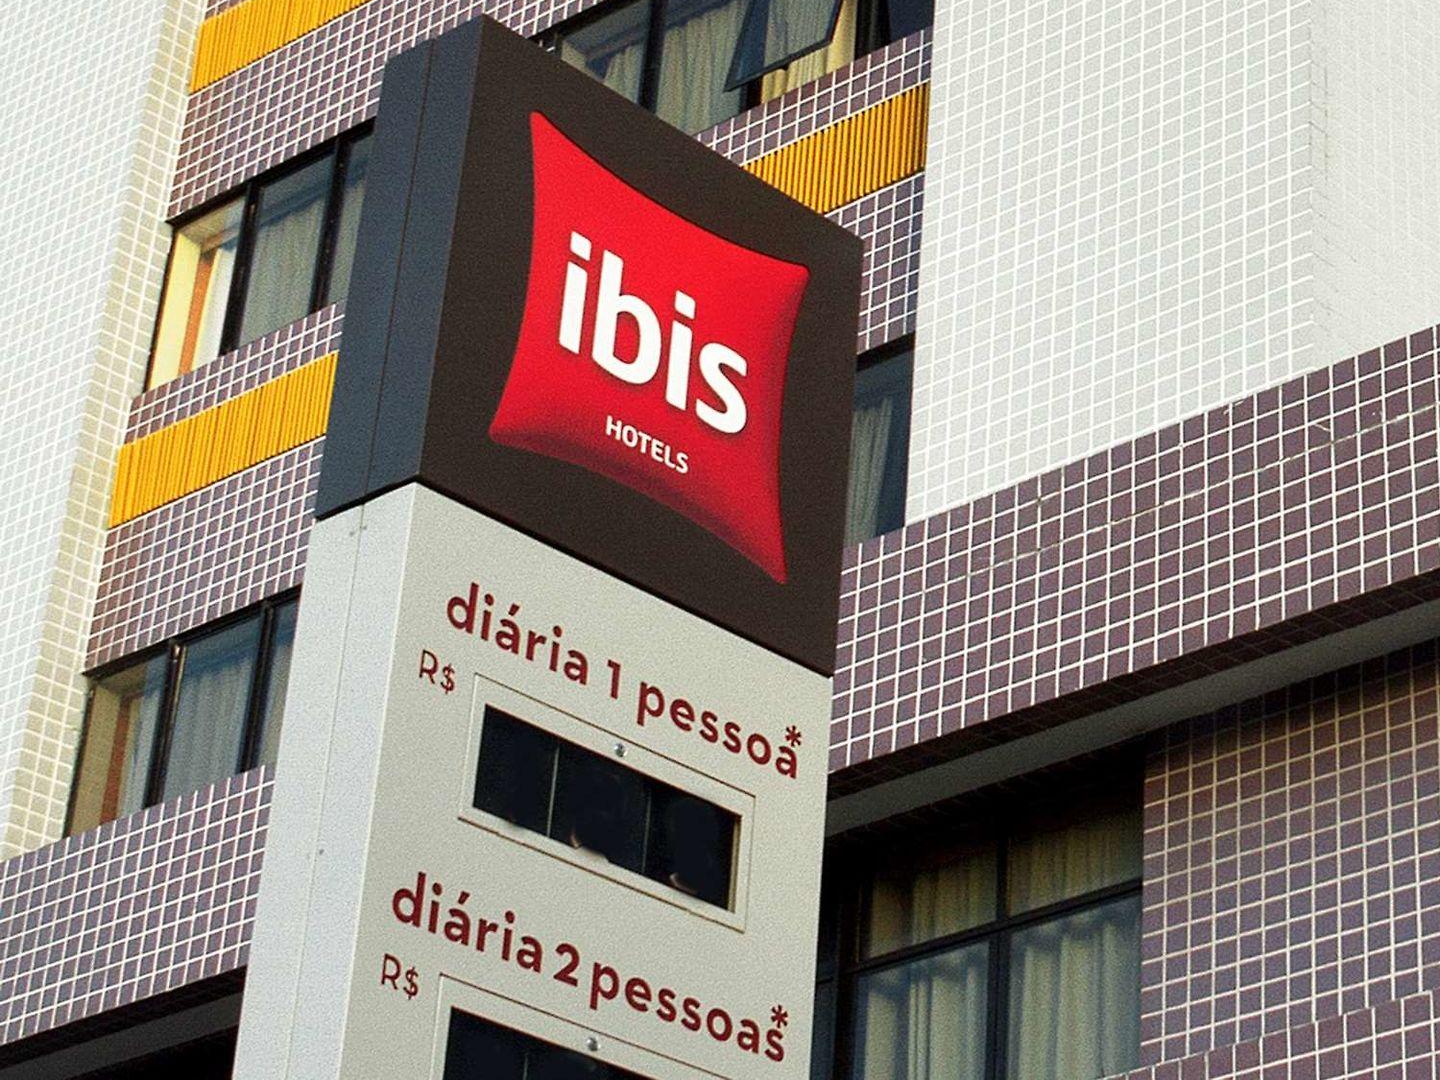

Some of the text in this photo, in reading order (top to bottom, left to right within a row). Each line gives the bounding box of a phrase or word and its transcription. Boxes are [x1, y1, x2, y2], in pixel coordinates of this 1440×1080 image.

[558, 231, 748, 434] ibis
[605, 415, 689, 475] HOTELS
[418, 649, 456, 695] R$
[446, 581, 588, 685] diária
[606, 658, 622, 700] 1
[391, 871, 543, 974] diária
[553, 942, 581, 988] 2
[380, 952, 420, 1000] R$
